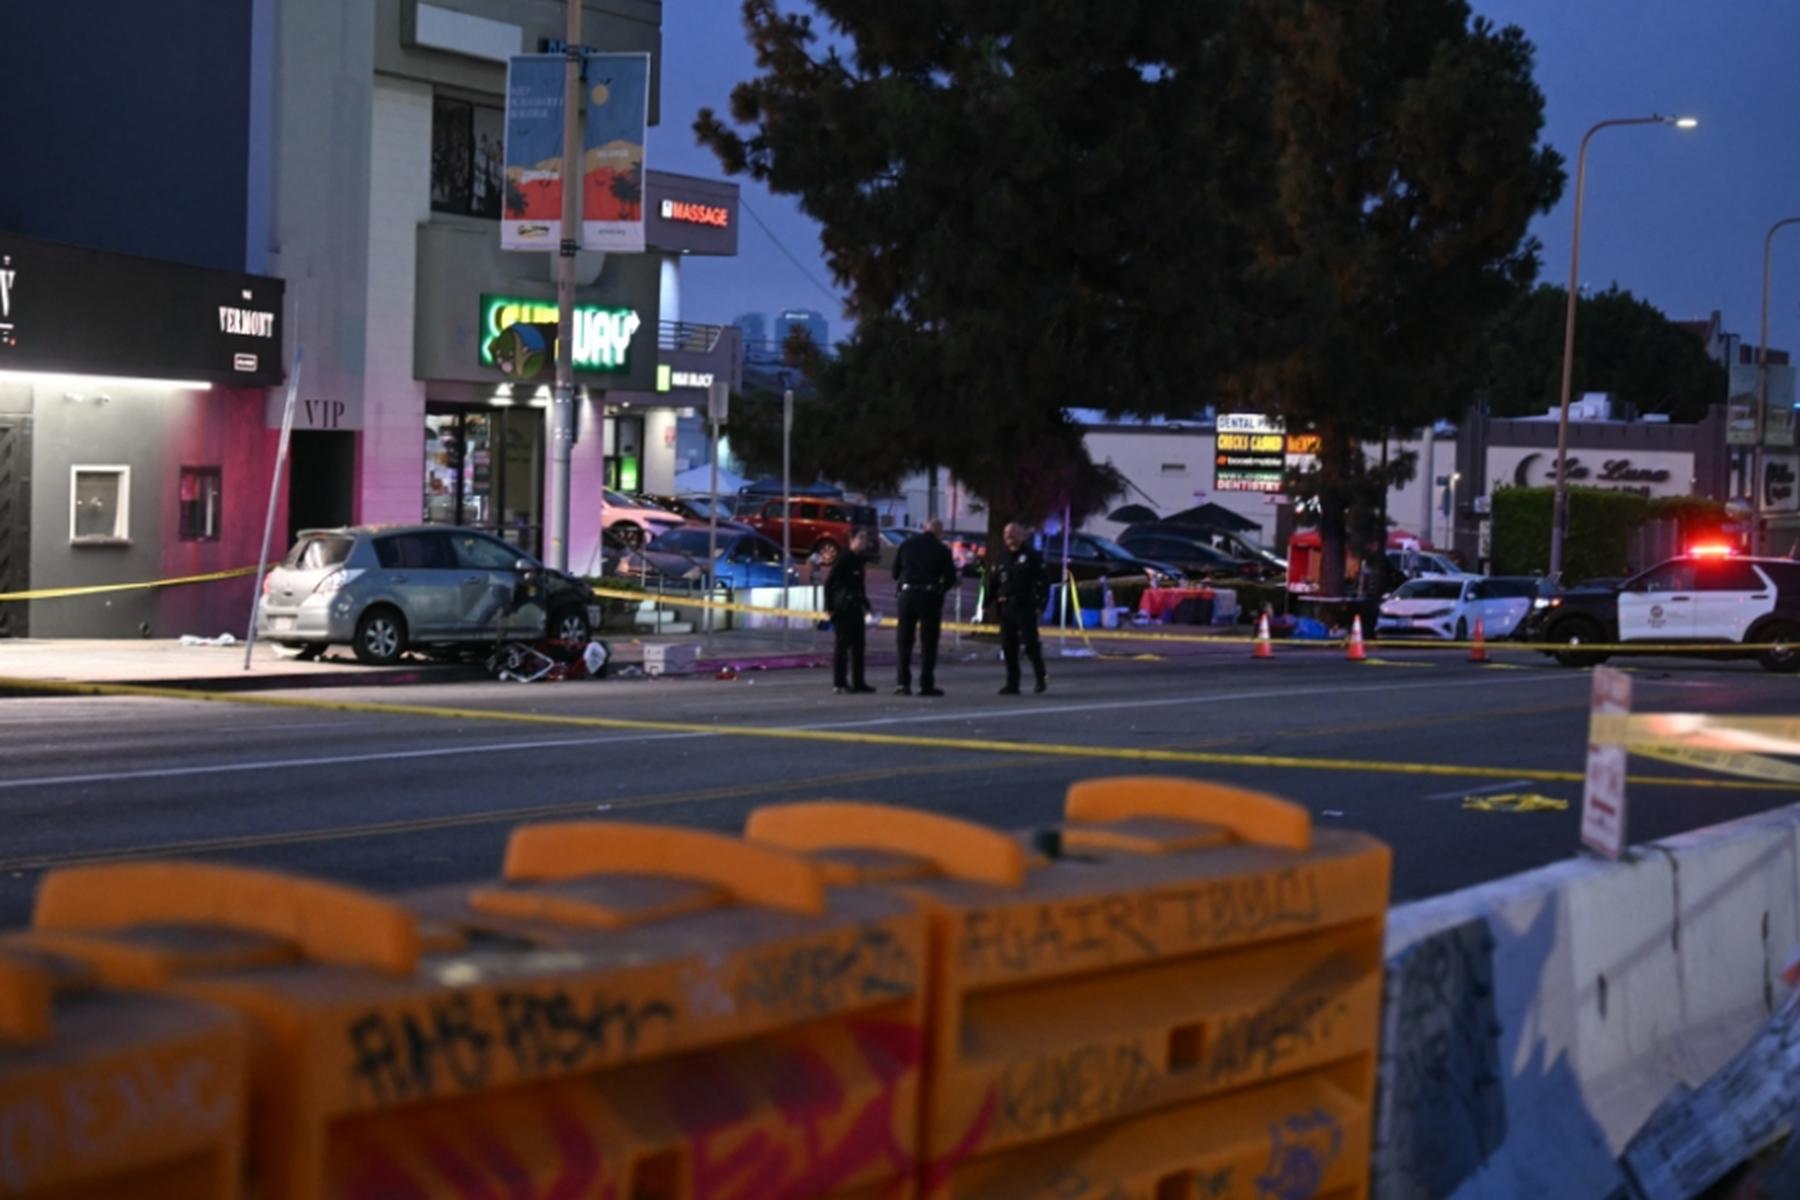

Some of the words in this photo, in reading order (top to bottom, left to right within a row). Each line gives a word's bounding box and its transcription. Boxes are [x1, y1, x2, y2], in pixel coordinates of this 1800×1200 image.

[673, 201, 728, 226] MASSAGE
[218, 306, 275, 338] VERMONT
[304, 399, 345, 428] VIP
[1219, 417, 1254, 429] DENTAL
[1596, 458, 1670, 482] Luna
